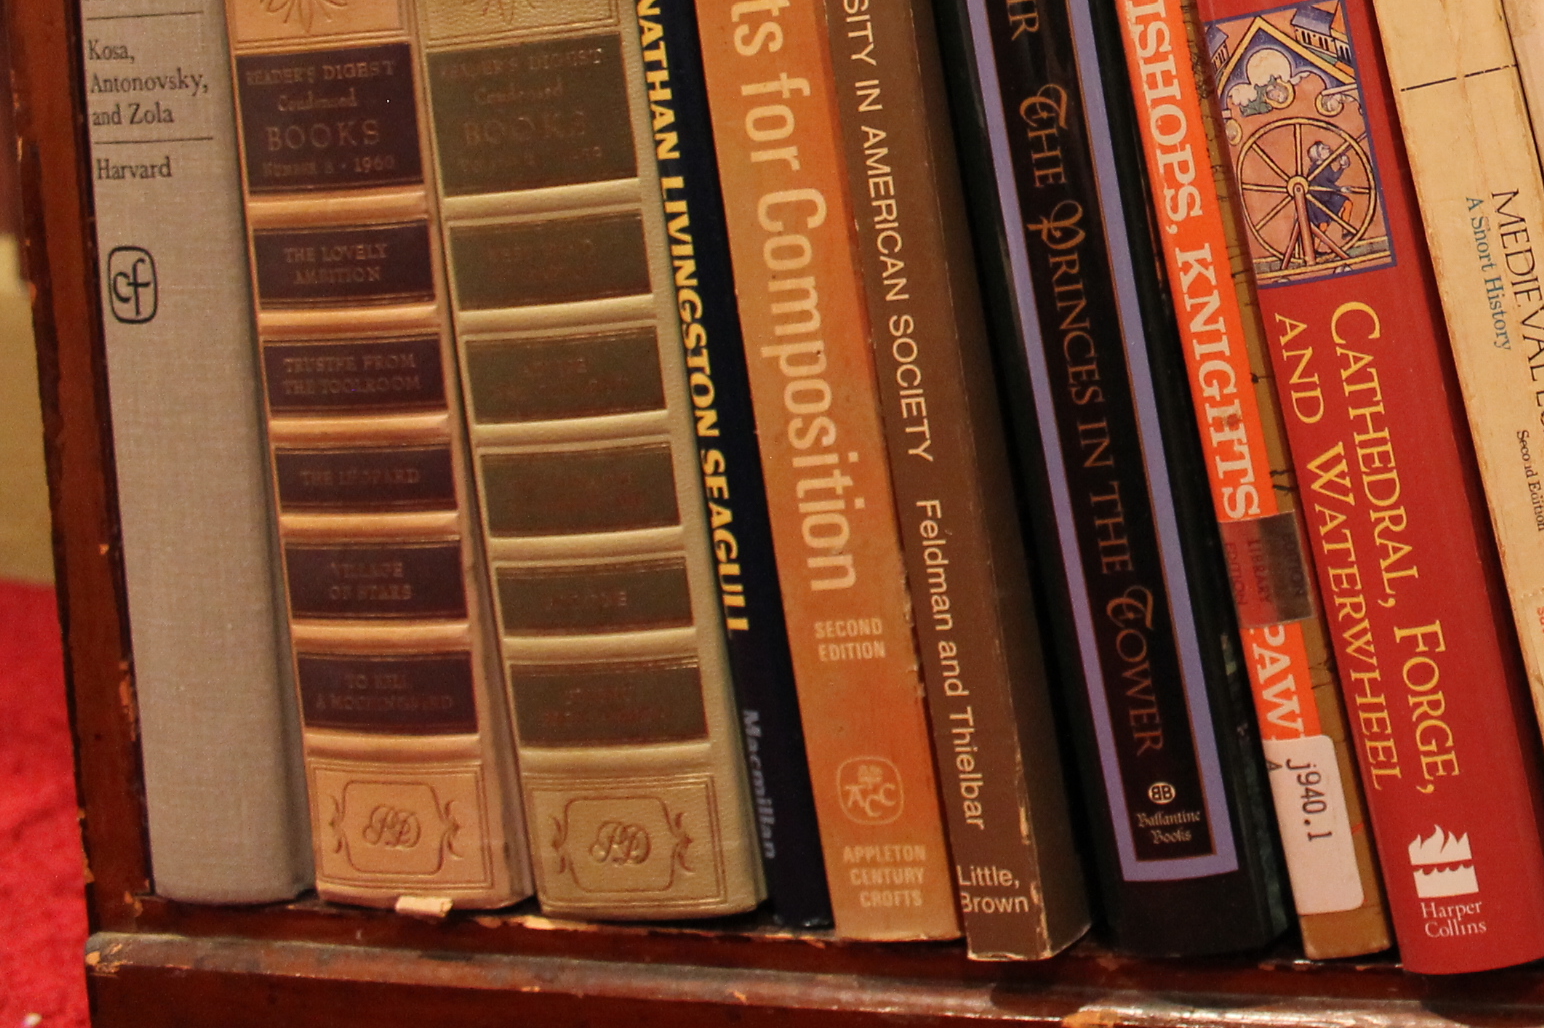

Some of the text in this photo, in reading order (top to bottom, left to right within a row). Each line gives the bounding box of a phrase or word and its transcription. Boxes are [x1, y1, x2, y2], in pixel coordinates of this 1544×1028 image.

[87, 39, 136, 63] Kosa,
[90, 68, 209, 96] Antonovsky,
[322, 60, 397, 82] DIGEST
[853, 77, 885, 114] IN
[92, 101, 175, 126] and Zola
[739, 72, 811, 173] for
[265, 117, 382, 153] BOOKS
[96, 156, 174, 182] Harvard
[859, 123, 911, 303] AMERICAN
[283, 241, 390, 264] THE LOVELY
[661, 175, 720, 436] LIVINGSTON
[1483, 276, 1513, 352] History
[363, 352, 417, 371] FROM
[756, 187, 866, 593] Composition
[888, 313, 935, 464] SOCIETY
[1174, 242, 1261, 520] KNIGHTS
[1018, 83, 1165, 757] THE PRINCES IN THE TOWER
[1274, 312, 1403, 791] AND WATERWHEEL
[1330, 300, 1461, 795] CATHEDRAL, FORGE,
[914, 498, 956, 632] Feldman
[814, 617, 884, 640] SECOND
[818, 639, 887, 663] EDITION
[936, 638, 971, 698] and
[947, 706, 987, 831] Thielbar
[1286, 758, 1334, 842] j940.1
[1135, 810, 1201, 829] Ballantine
[1151, 828, 1193, 845] Books
[842, 843, 927, 864] APPLETON
[850, 866, 925, 887] CENTURY
[956, 864, 1021, 890] Little,
[858, 889, 923, 909] CROFTS
[960, 890, 1030, 915] Brown
[1420, 900, 1483, 922] Harper
[1424, 918, 1488, 939] Collins
